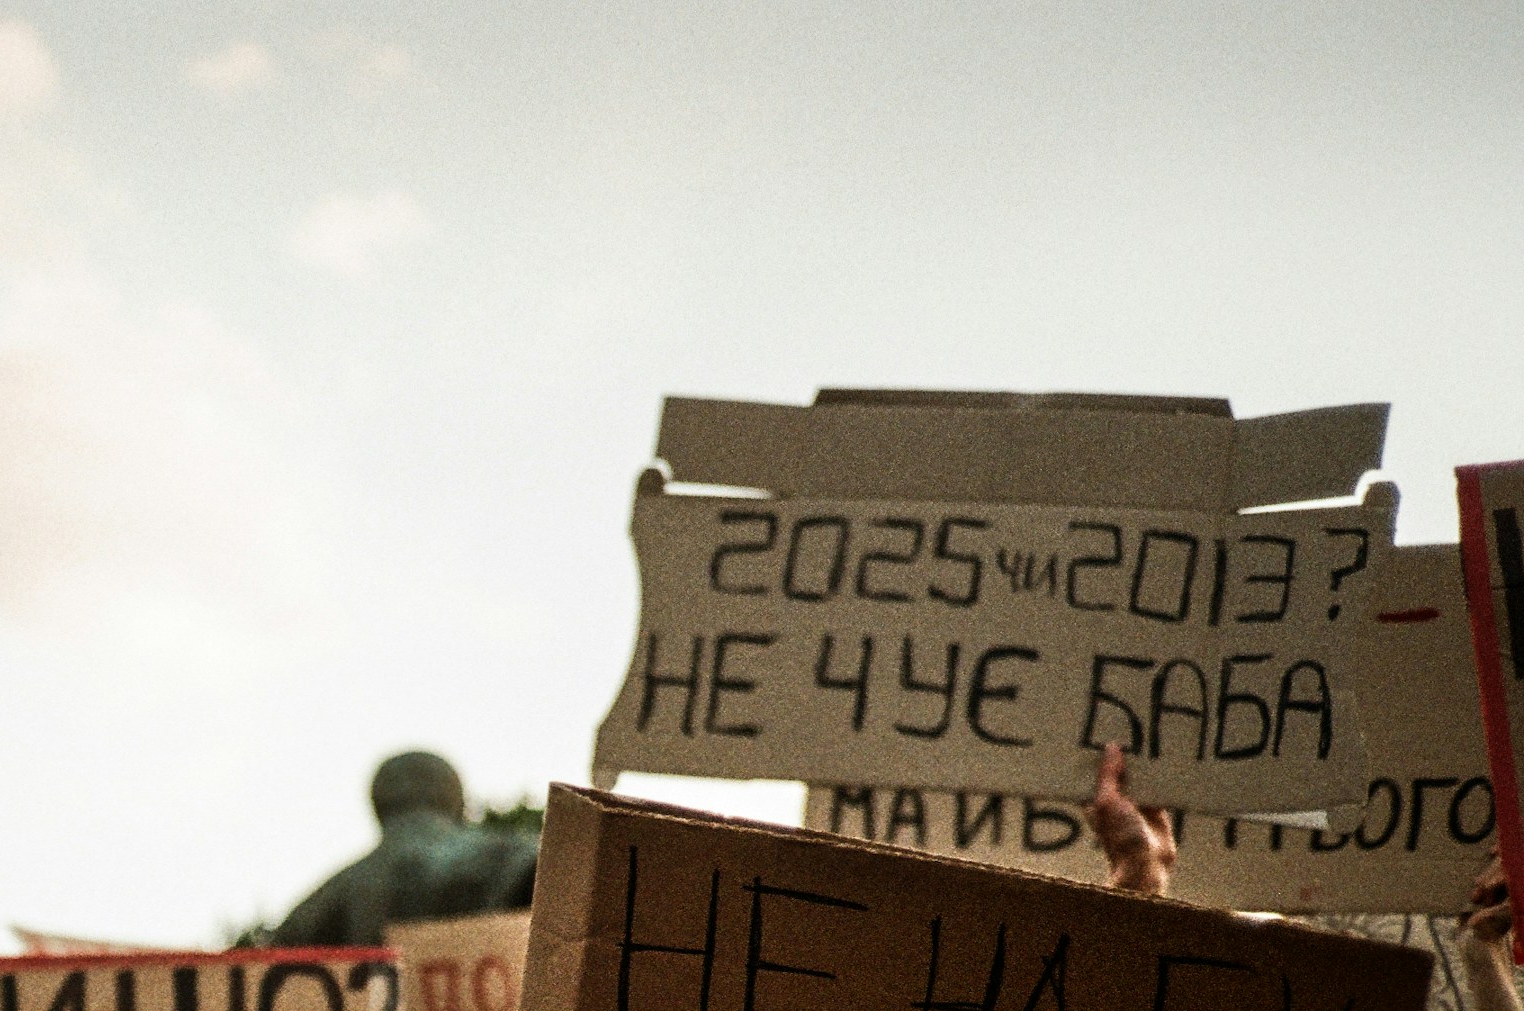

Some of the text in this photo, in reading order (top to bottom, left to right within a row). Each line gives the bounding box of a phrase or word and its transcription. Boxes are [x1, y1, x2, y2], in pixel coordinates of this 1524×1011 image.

[710, 509, 987, 608] 2025
[635, 632, 1335, 762] НЕ ЧУЄ БАБА
